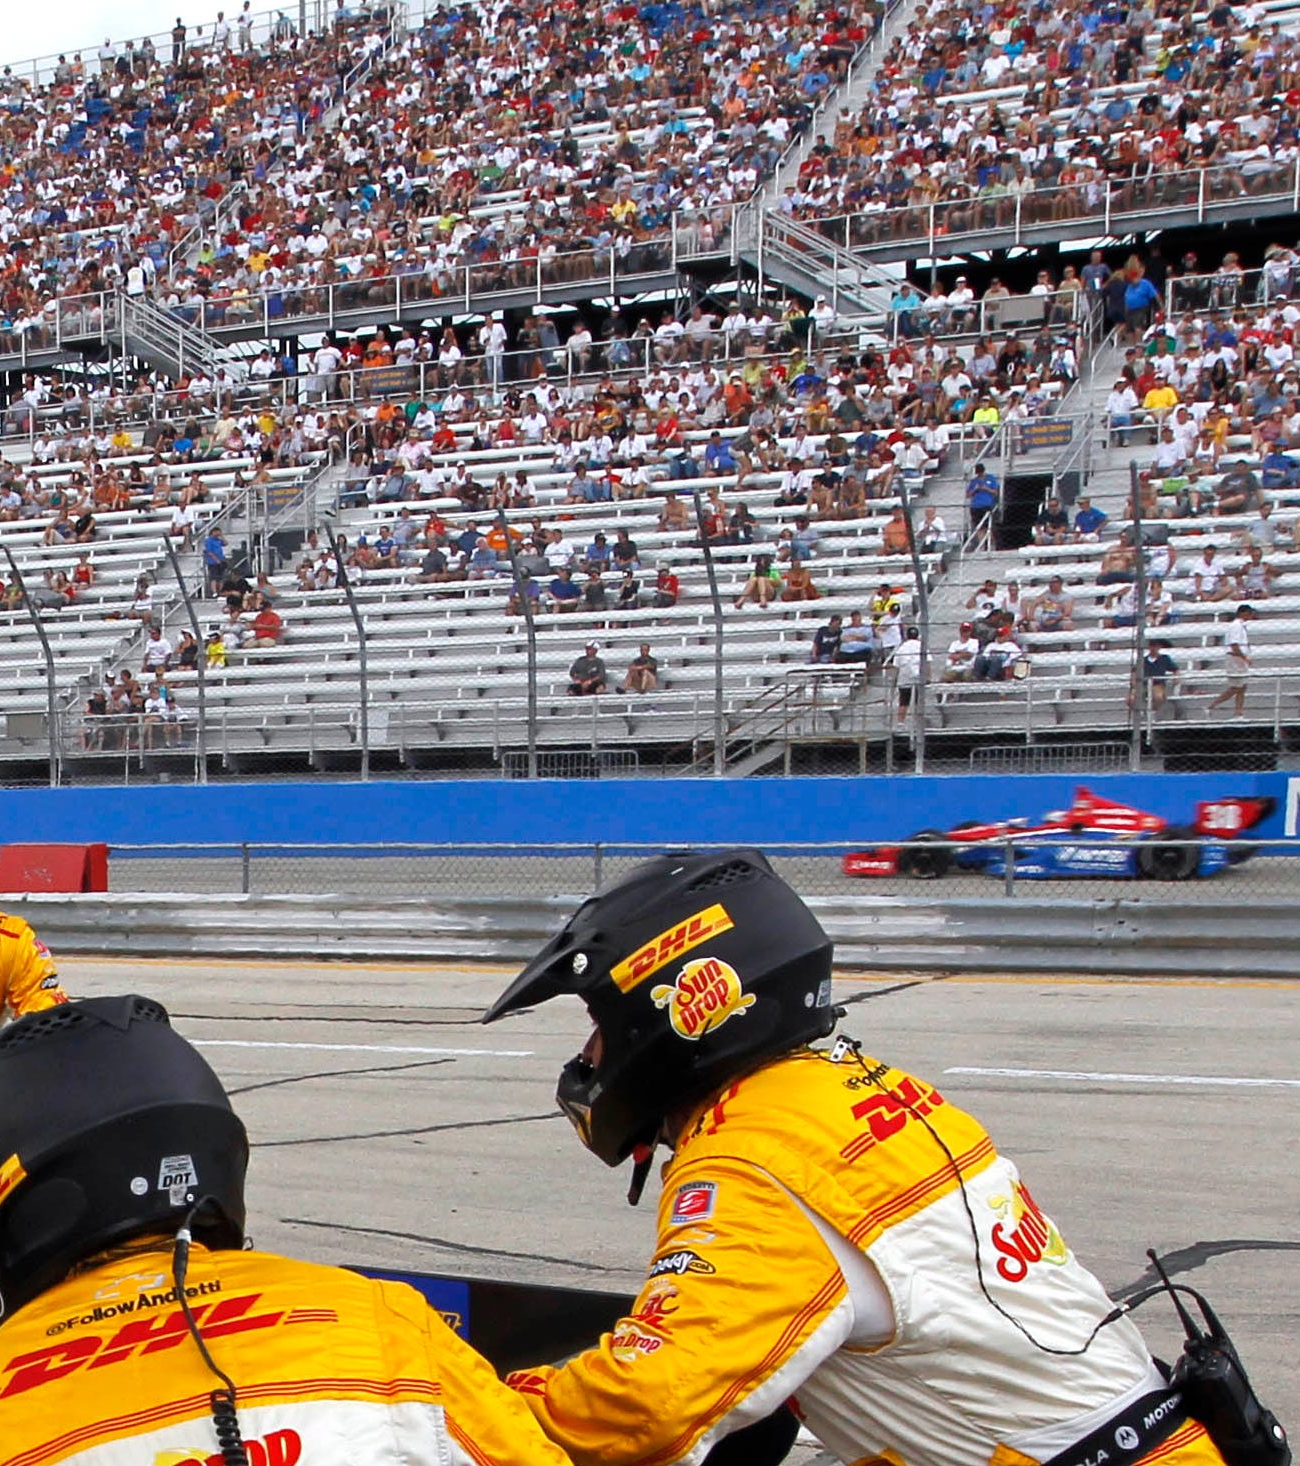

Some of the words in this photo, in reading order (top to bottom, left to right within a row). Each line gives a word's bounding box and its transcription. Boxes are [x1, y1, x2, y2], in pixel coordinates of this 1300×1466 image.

[628, 917, 714, 979] DHL
[676, 959, 724, 1007] Sun
[679, 978, 731, 1036] Drop
[162, 1172, 191, 1188] DOT
[991, 1209, 1049, 1284] Sun
[46, 1279, 222, 1337] @FollowAndretti
[625, 1334, 662, 1355] Drop
[1143, 1395, 1182, 1430] MOTO
